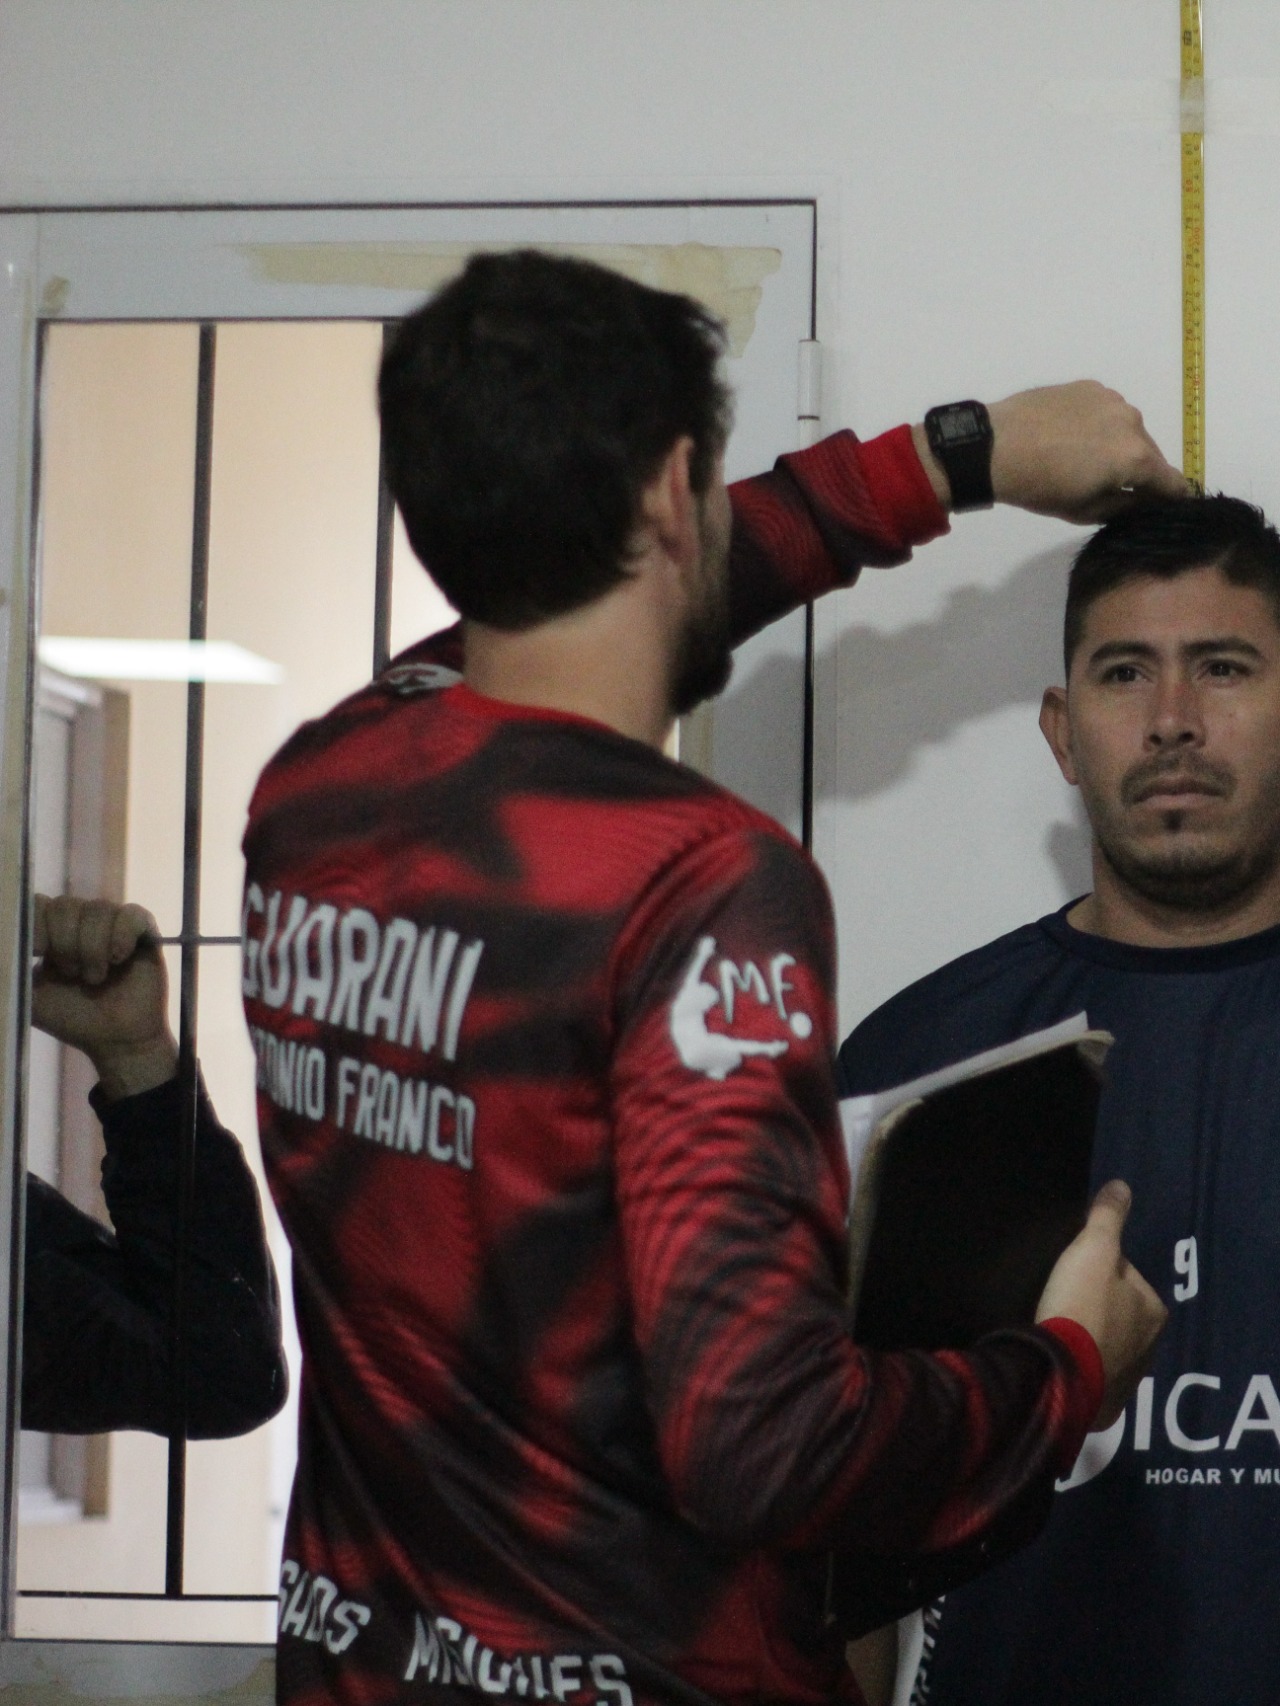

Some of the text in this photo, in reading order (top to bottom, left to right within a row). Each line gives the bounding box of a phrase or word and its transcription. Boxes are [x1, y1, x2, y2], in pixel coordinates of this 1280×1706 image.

[250, 1026, 476, 1171] TONIO FRANCO
[1174, 1235, 1199, 1302] 9
[1146, 1468, 1221, 1485] HOGAR
[1230, 1468, 1245, 1485] Y
